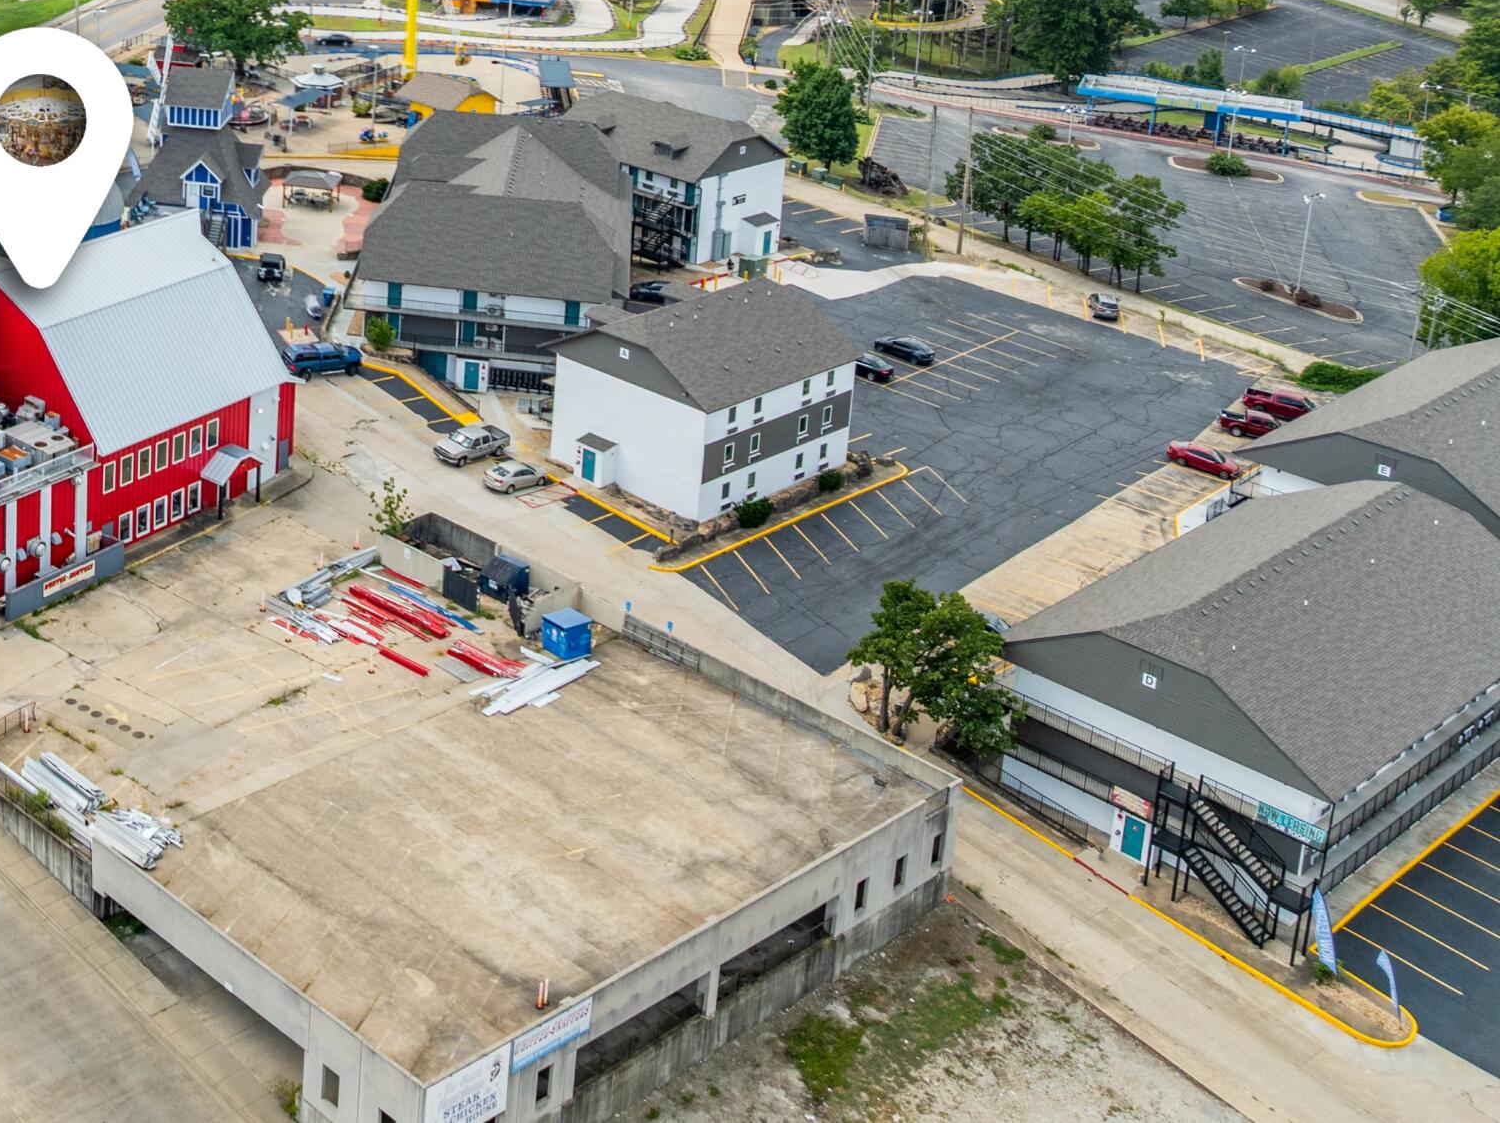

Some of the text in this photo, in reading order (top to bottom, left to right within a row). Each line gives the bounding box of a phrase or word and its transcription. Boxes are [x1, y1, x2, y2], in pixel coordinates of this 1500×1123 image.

[1258, 802, 1323, 841] NOW LEASING
[1268, 819, 1311, 844] TOUR TODAY
[443, 1089, 482, 1119] STEAK
[449, 1093, 497, 1123] CHICKEN
[466, 1100, 498, 1123] HOUSE
